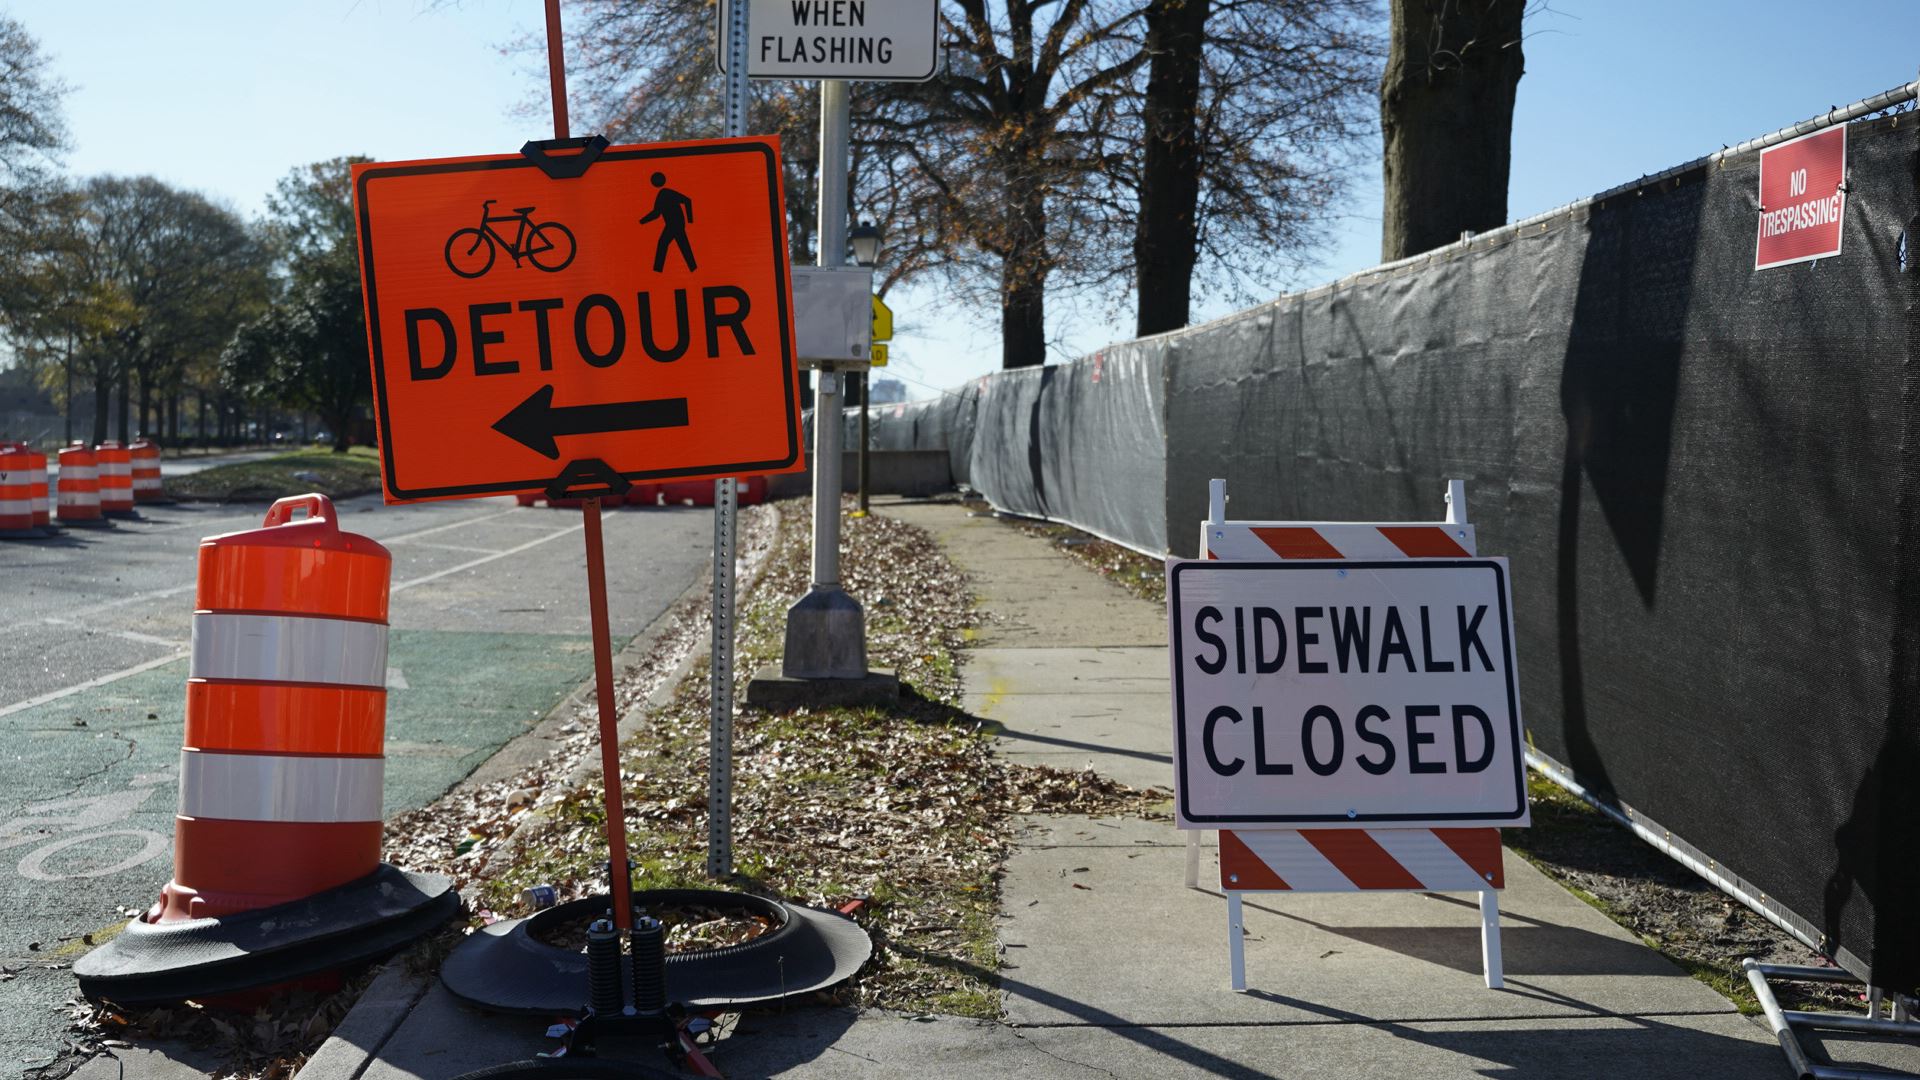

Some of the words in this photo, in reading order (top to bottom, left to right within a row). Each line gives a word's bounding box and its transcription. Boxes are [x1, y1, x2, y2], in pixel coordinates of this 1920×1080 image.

[792, 0, 865, 26] WHEN
[760, 36, 893, 64] FLASHING
[1790, 168, 1807, 198] NO
[1762, 195, 1838, 238] TRESPASSING
[404, 285, 756, 382] DETOUR
[1194, 605, 1495, 675] SIDEWALK
[1202, 704, 1495, 777] CLOSED
